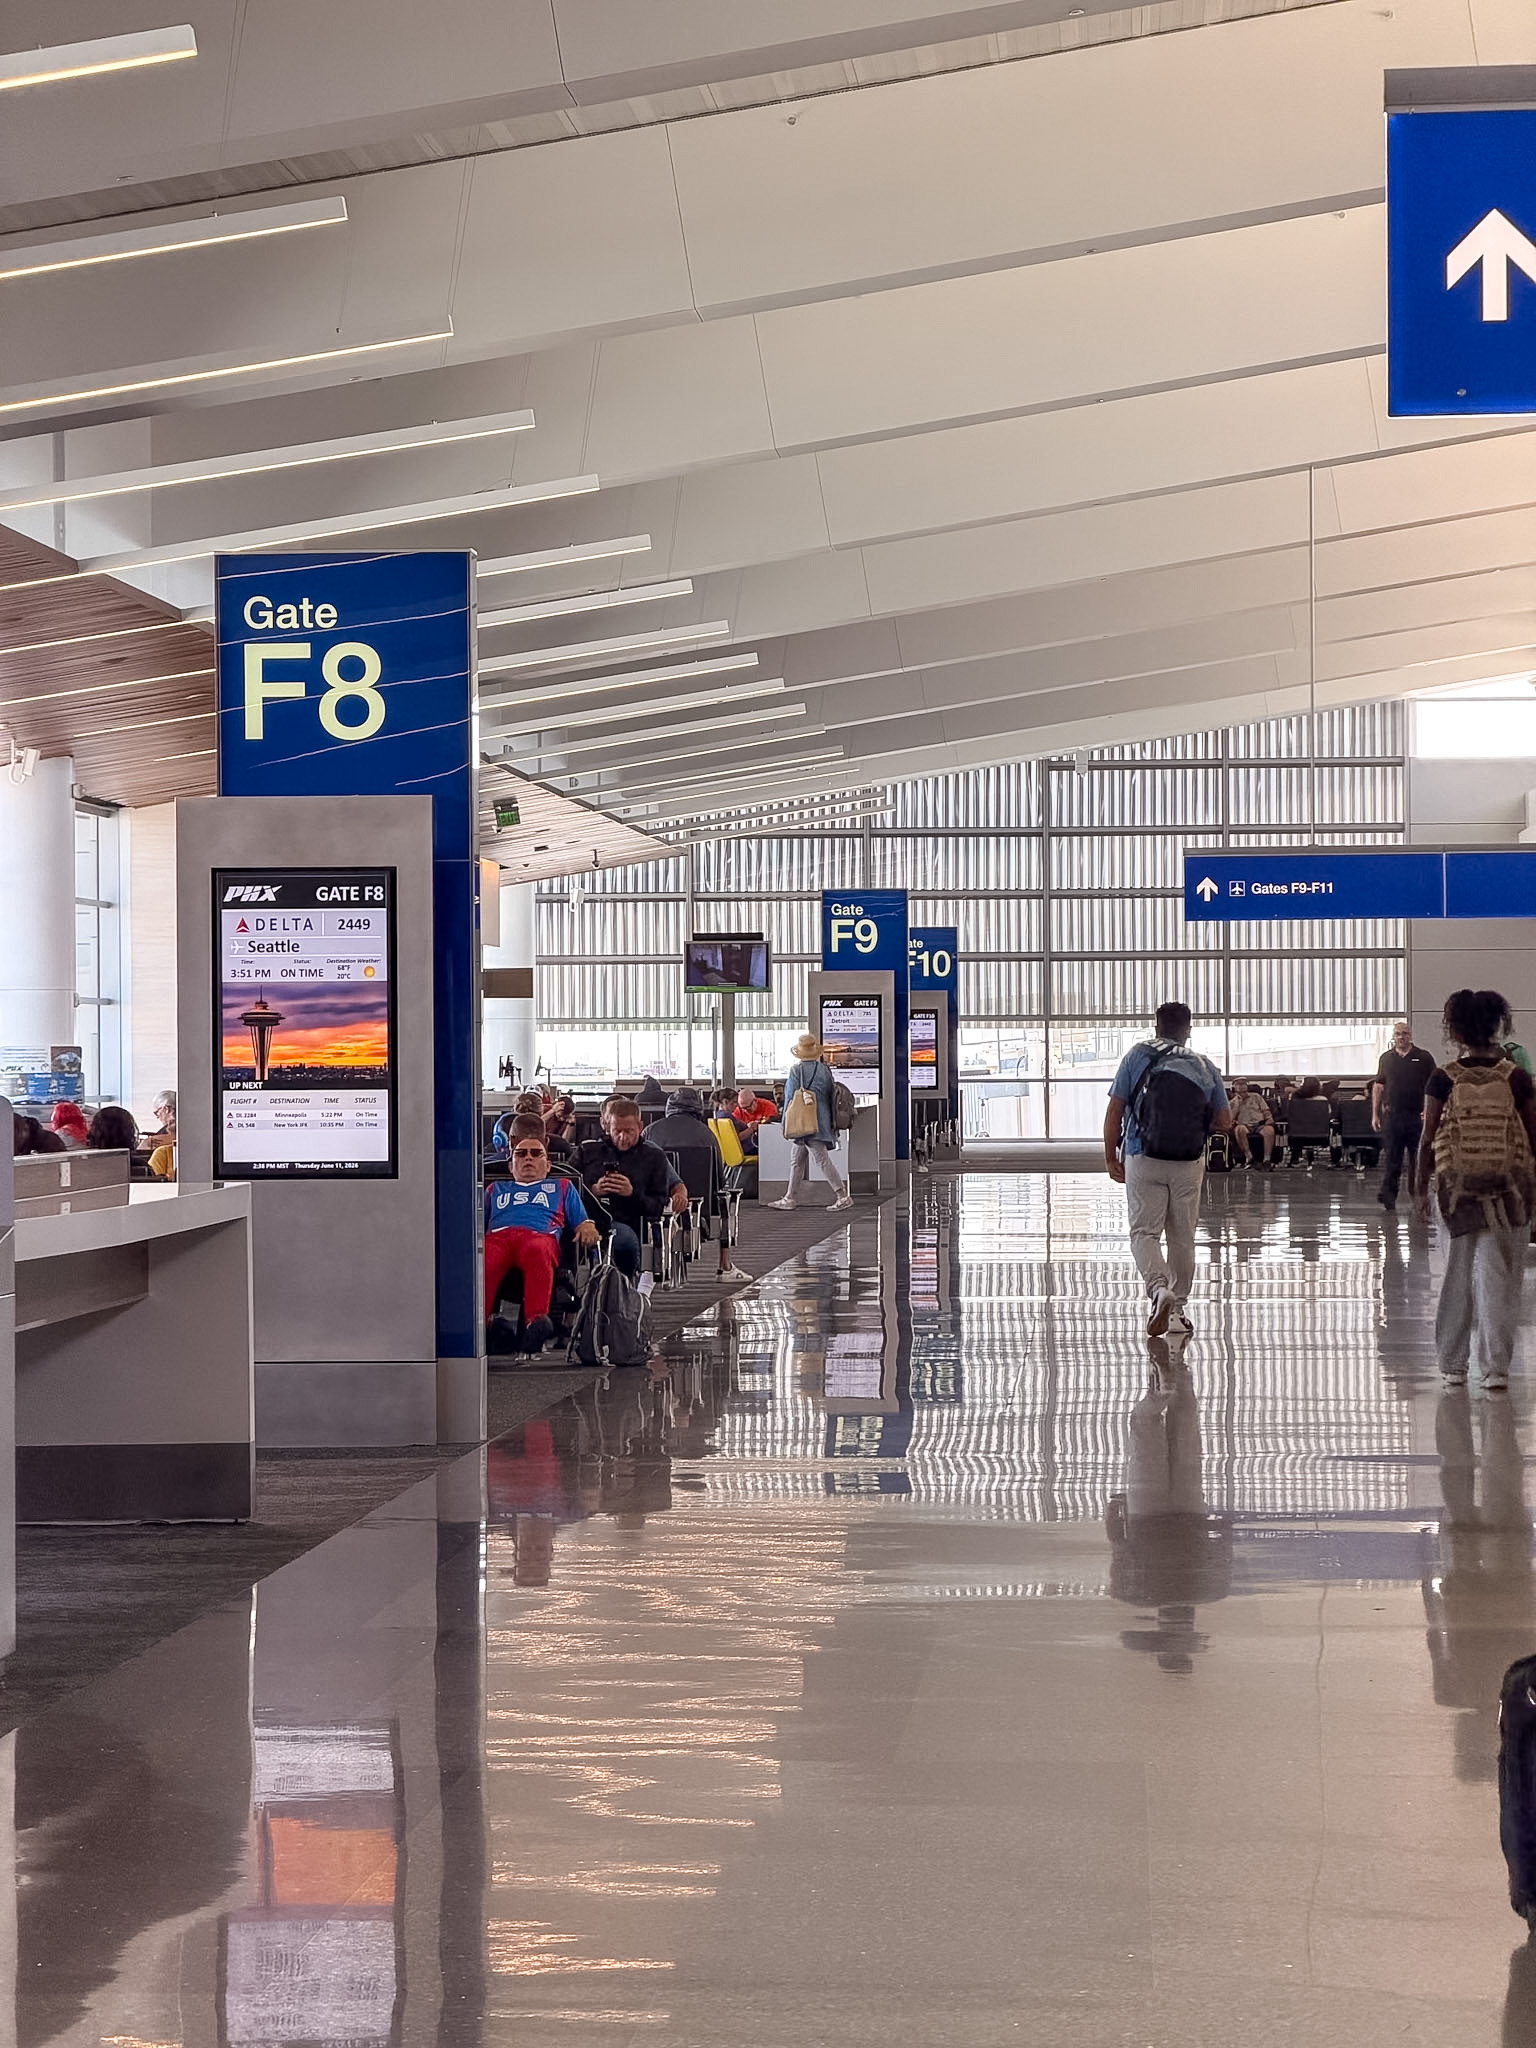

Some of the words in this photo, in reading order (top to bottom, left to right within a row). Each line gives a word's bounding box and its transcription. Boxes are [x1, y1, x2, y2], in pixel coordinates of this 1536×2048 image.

[243, 595, 338, 630] Gate
[243, 641, 386, 741] F8
[223, 885, 283, 902] PHX
[316, 886, 360, 901] GATE
[364, 886, 384, 901] F8
[1251, 882, 1288, 895] Gates
[1291, 882, 1333, 894] F9-F11
[830, 903, 864, 916] Gate
[255, 918, 314, 931] DELTA
[337, 918, 371, 931] 2449
[830, 919, 878, 953] F9
[248, 939, 300, 953] Seattle
[908, 939, 923, 948] ate
[230, 969, 252, 978] 3:51
[254, 969, 271, 978] PM
[280, 968, 296, 977] ON
[298, 968, 324, 977] TIME
[294, 1162, 320, 1170] Thursday
[496, 1191, 550, 1209] USA
